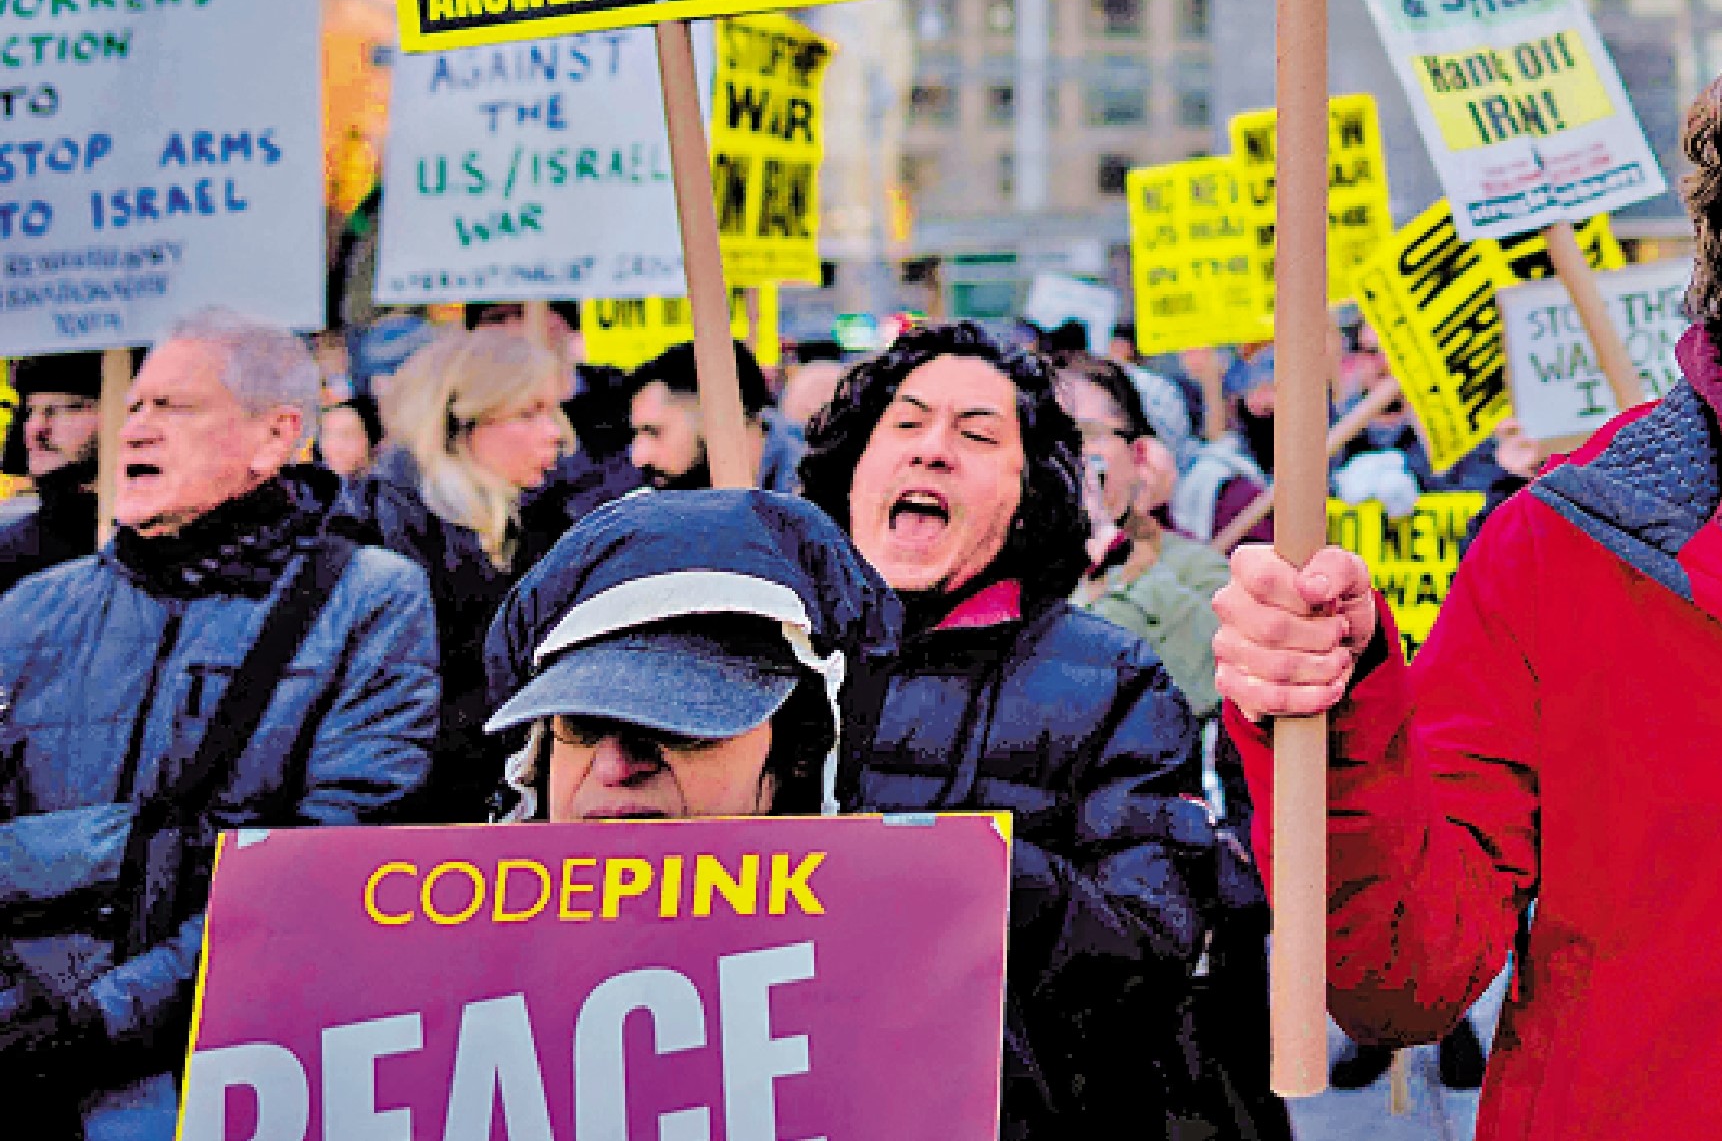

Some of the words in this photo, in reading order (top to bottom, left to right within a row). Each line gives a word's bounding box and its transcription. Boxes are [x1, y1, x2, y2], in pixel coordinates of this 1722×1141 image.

[1, 27, 132, 67] CTION
[0, 83, 58, 120] TO
[480, 94, 570, 135] THE
[725, 80, 815, 144] WAR
[0, 132, 113, 184] STOP
[159, 127, 282, 167] ARMS
[0, 199, 52, 238] TO
[90, 177, 248, 230] ISRAEL
[455, 203, 545, 247] WAR
[1526, 305, 1584, 342] STO
[1527, 340, 1598, 384] WA
[364, 851, 827, 926] CODEPINK
